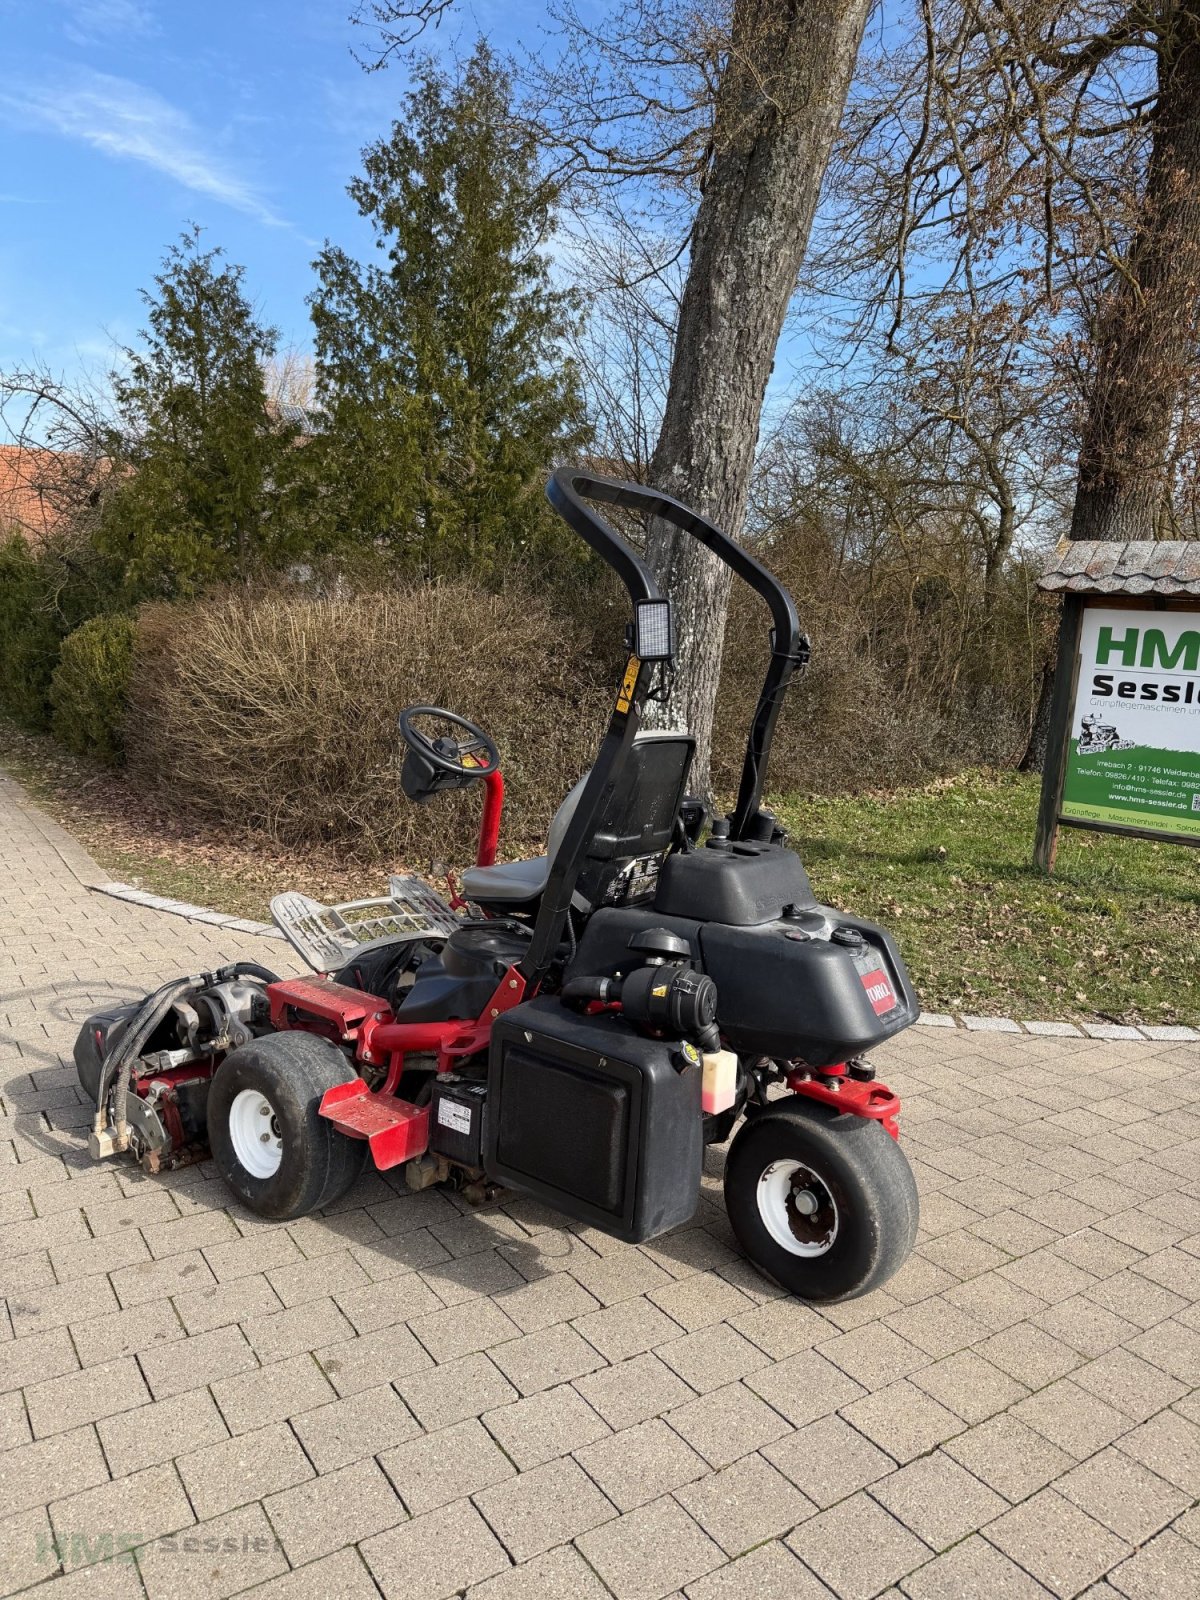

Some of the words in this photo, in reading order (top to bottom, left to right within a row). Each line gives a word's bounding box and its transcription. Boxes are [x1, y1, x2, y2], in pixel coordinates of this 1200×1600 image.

[1092, 675, 1200, 704] Sessl
[1090, 698, 1186, 713] Grünpflegemaschinen
[1076, 767, 1104, 777] Telefon:
[1151, 776, 1180, 787] Telefax:
[1138, 764, 1161, 774] 91746
[1108, 794, 1188, 810] www.hms-sessler.de
